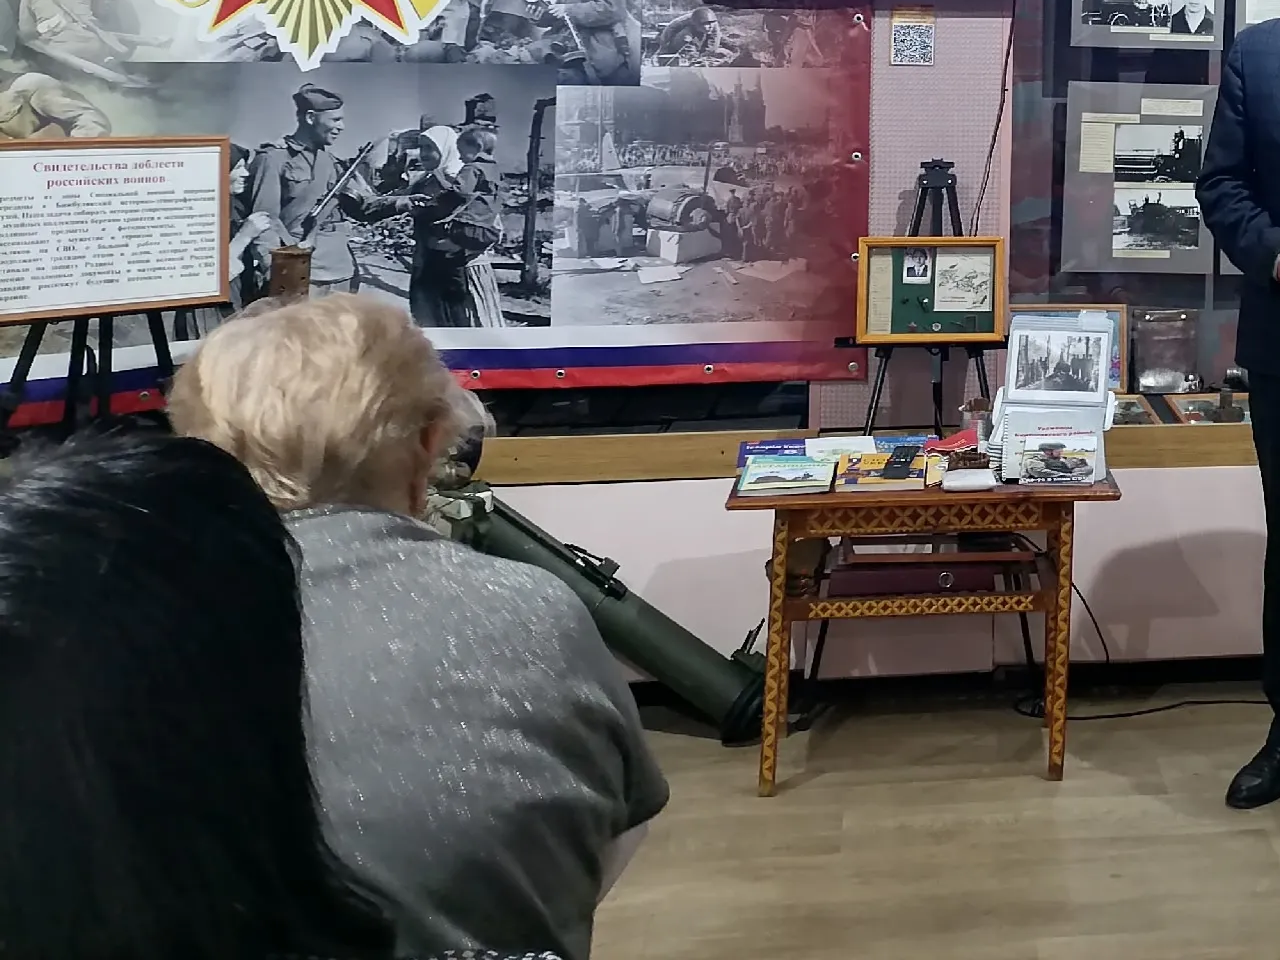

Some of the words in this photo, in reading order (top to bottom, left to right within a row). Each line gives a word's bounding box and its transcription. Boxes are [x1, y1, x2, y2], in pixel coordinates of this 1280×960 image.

[33, 160, 128, 173] Свидетельства
[131, 160, 184, 170] доблести
[46, 176, 119, 189] российских
[123, 176, 166, 185] воинов
